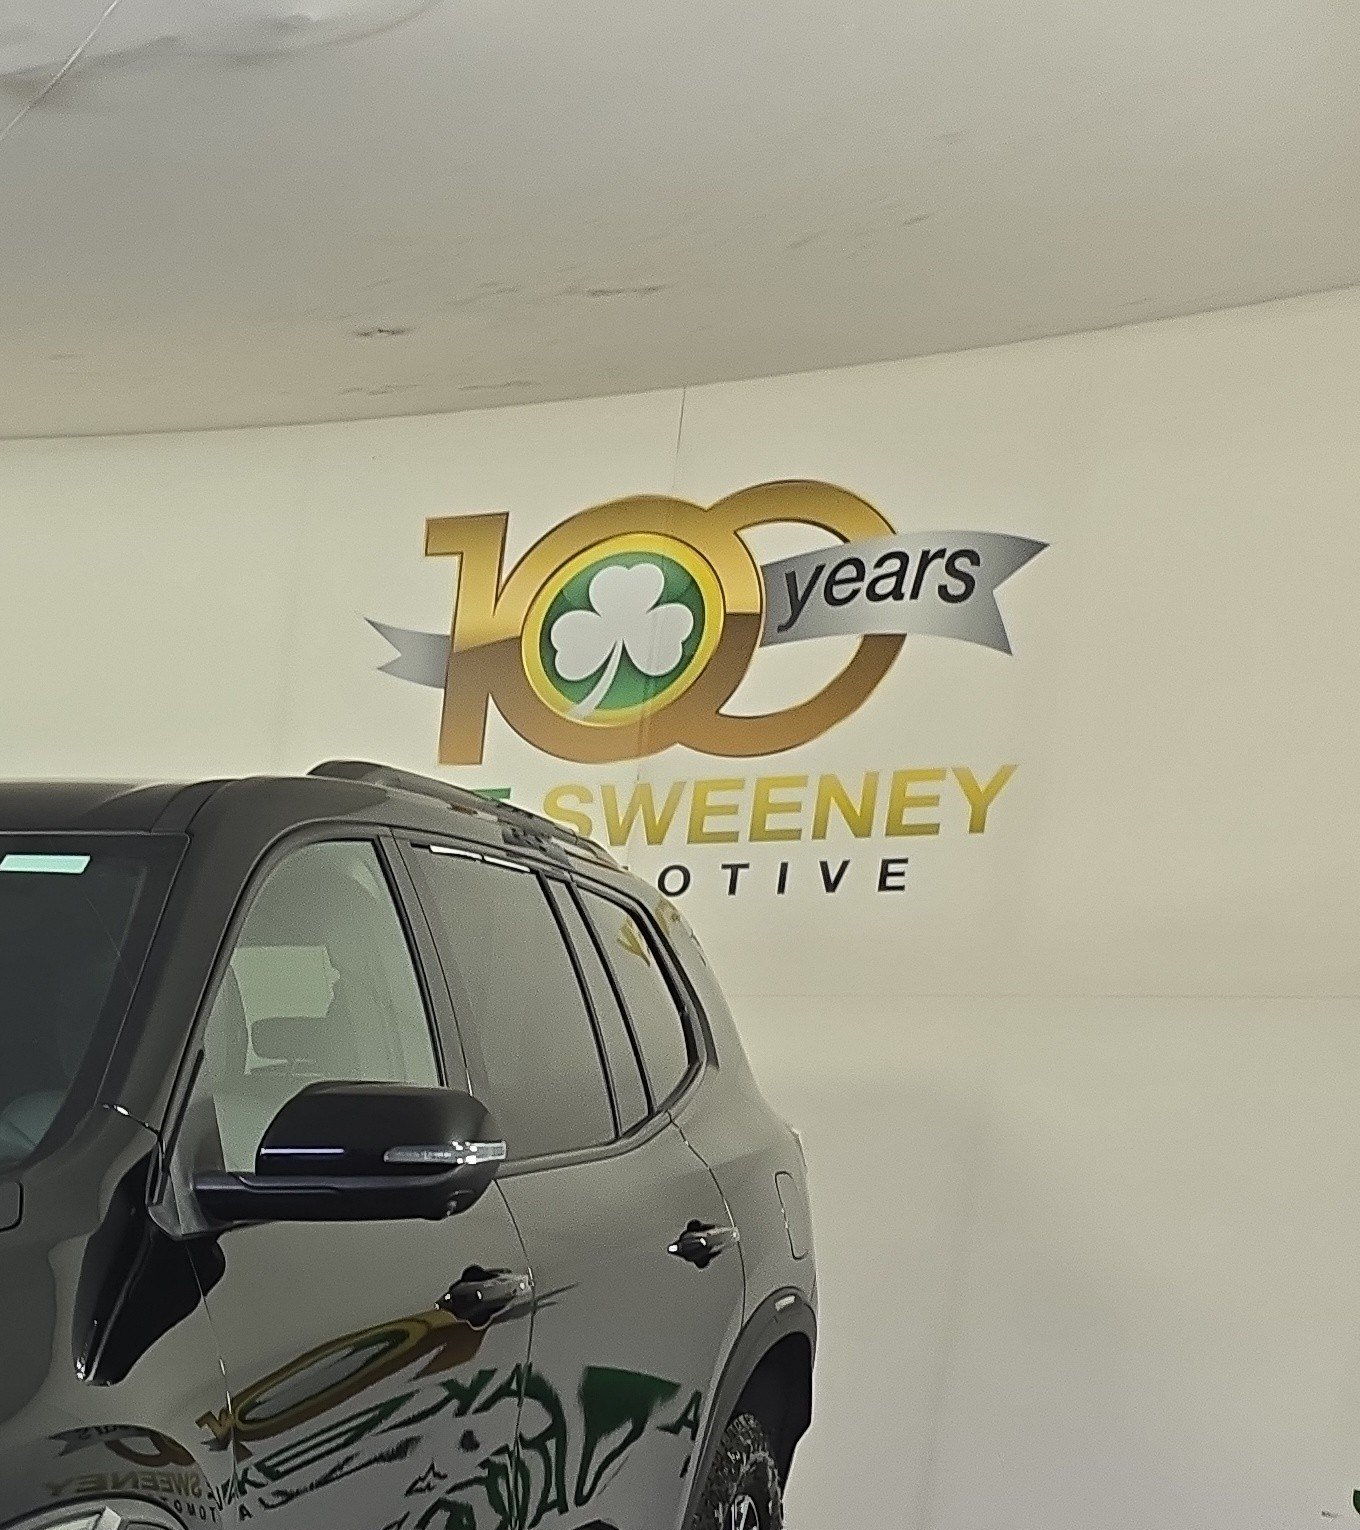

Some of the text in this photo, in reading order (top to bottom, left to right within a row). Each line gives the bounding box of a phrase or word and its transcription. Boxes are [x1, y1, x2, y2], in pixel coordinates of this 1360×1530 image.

[424, 479, 910, 766] 100
[776, 544, 982, 632] years
[542, 764, 1020, 847] SWEENEY
[627, 856, 910, 899] OTIVE
